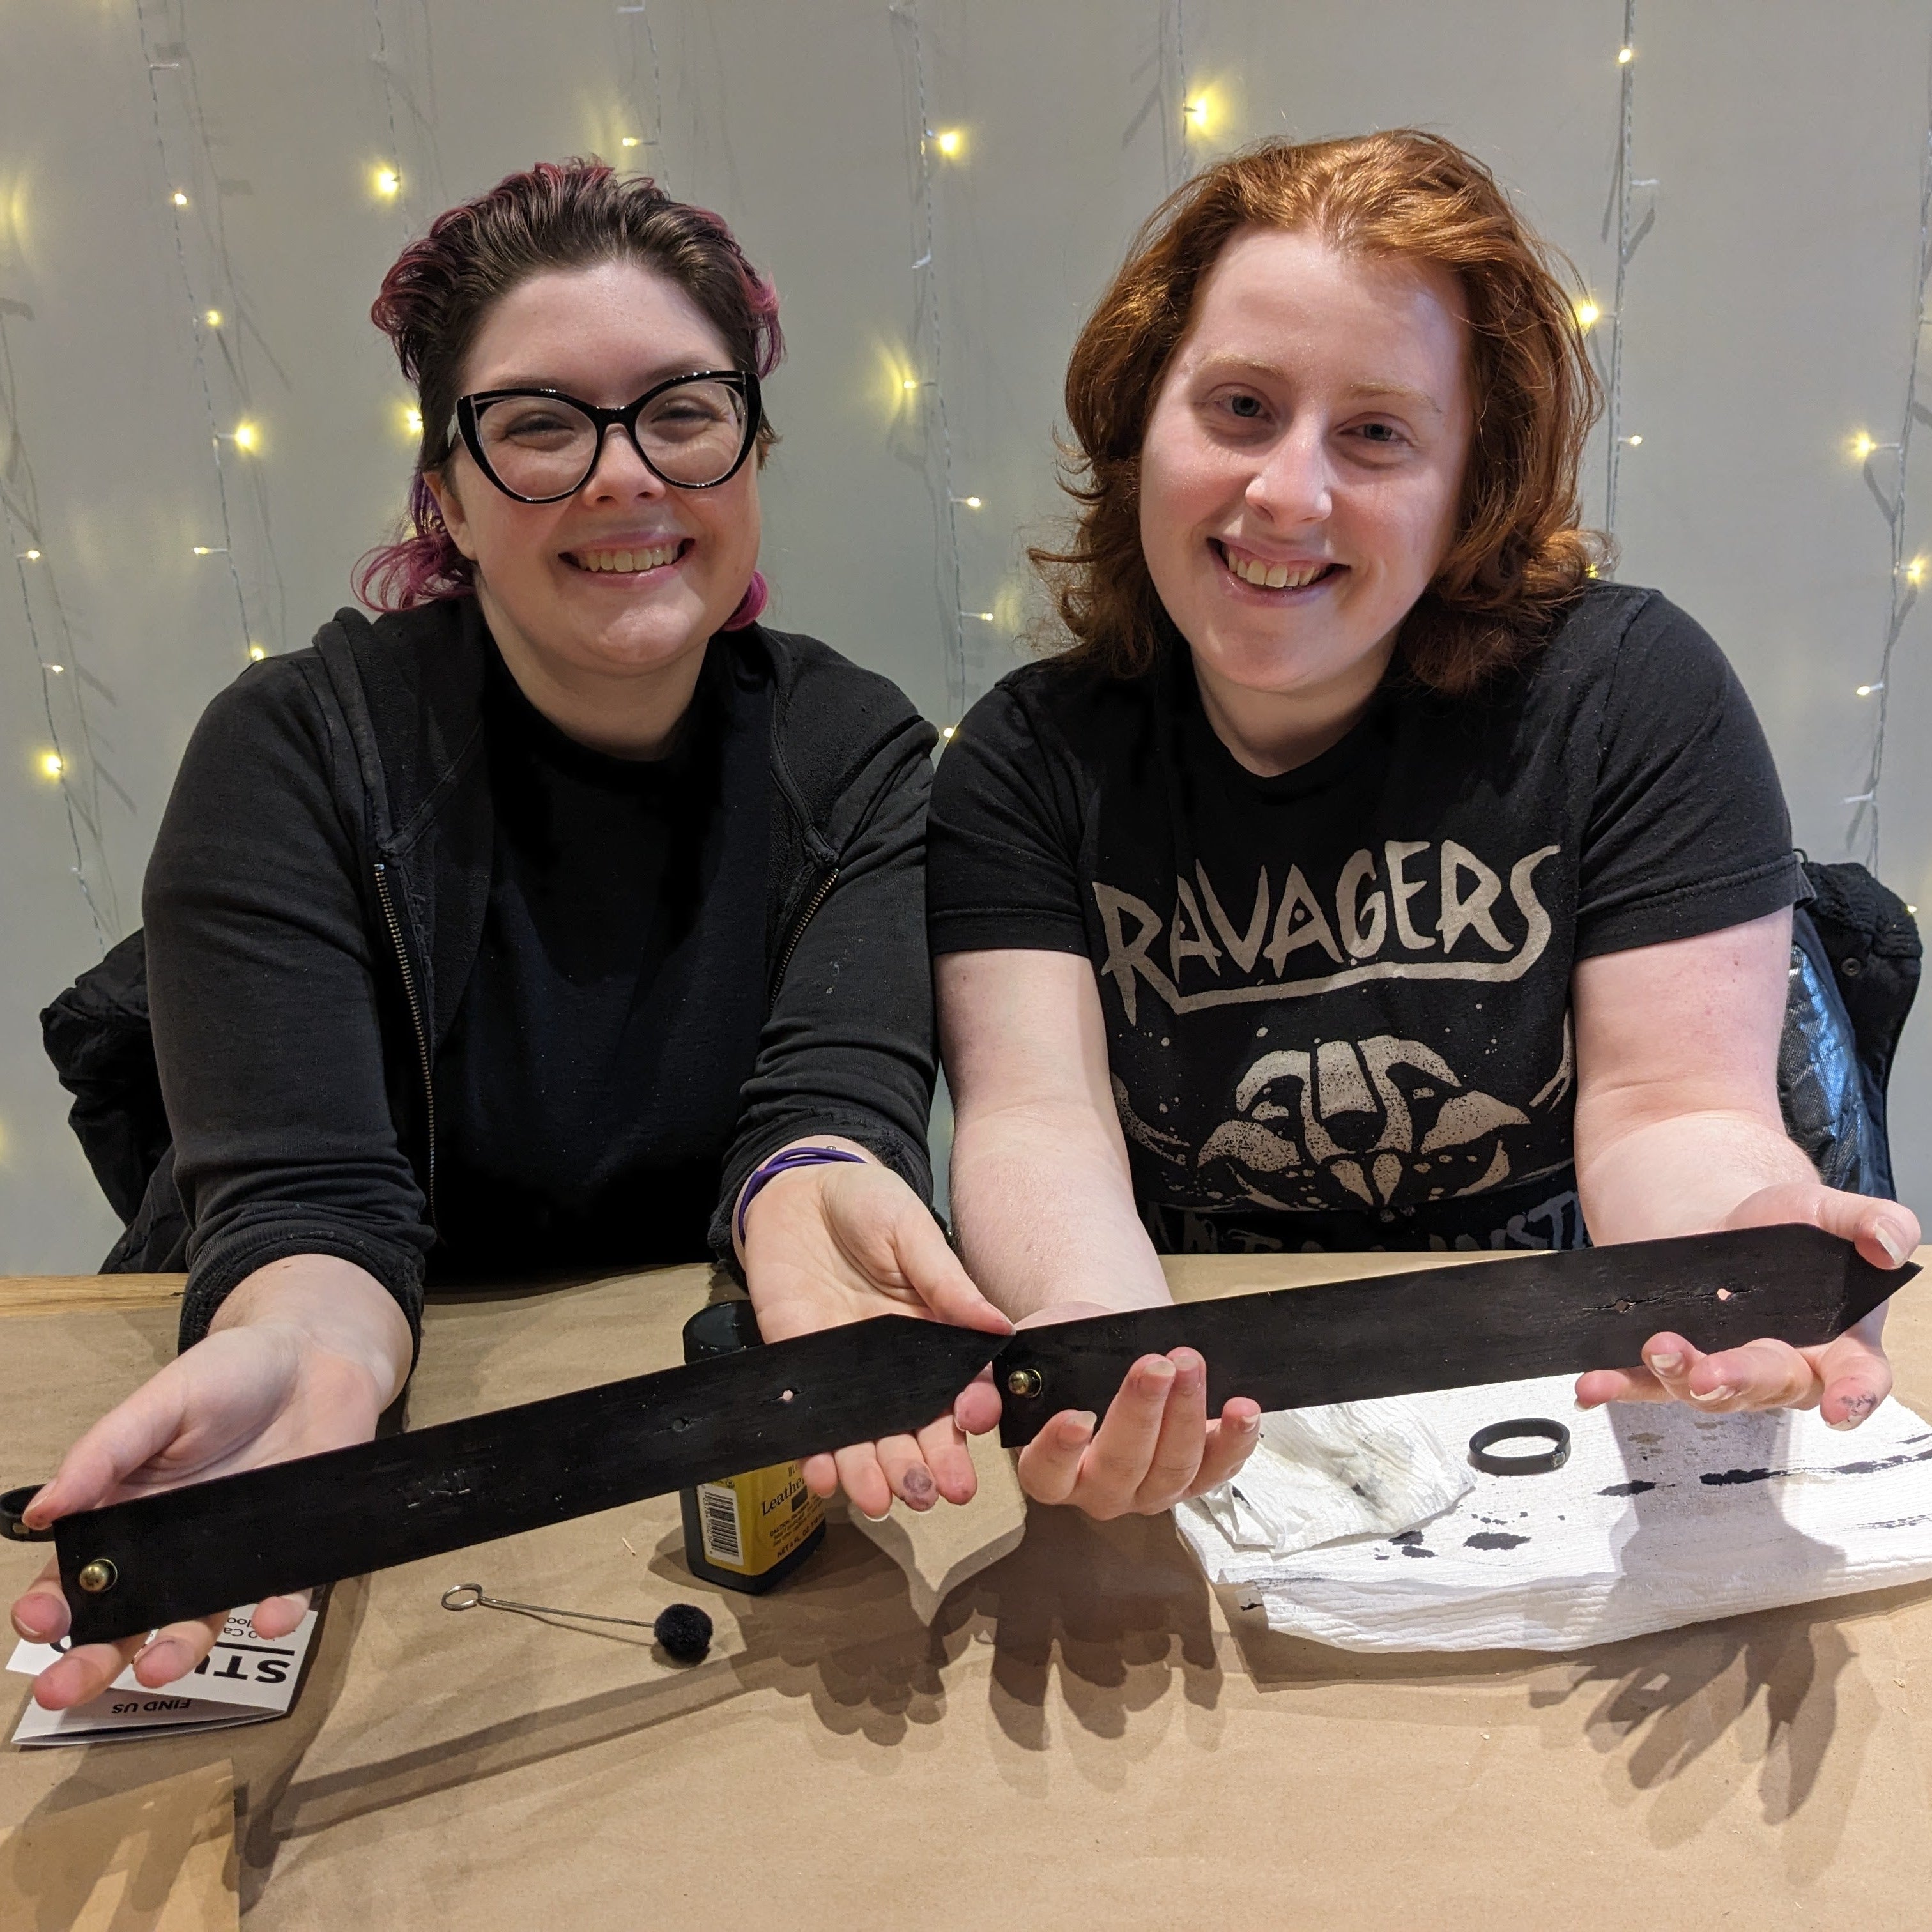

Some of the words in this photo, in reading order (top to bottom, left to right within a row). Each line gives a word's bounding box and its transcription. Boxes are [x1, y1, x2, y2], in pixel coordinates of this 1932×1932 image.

[1092, 839, 1561, 1025] RAVAGERS
[224, 1627, 244, 1637] Ca
[111, 1702, 139, 1714] US
[143, 1698, 192, 1712] FIND
